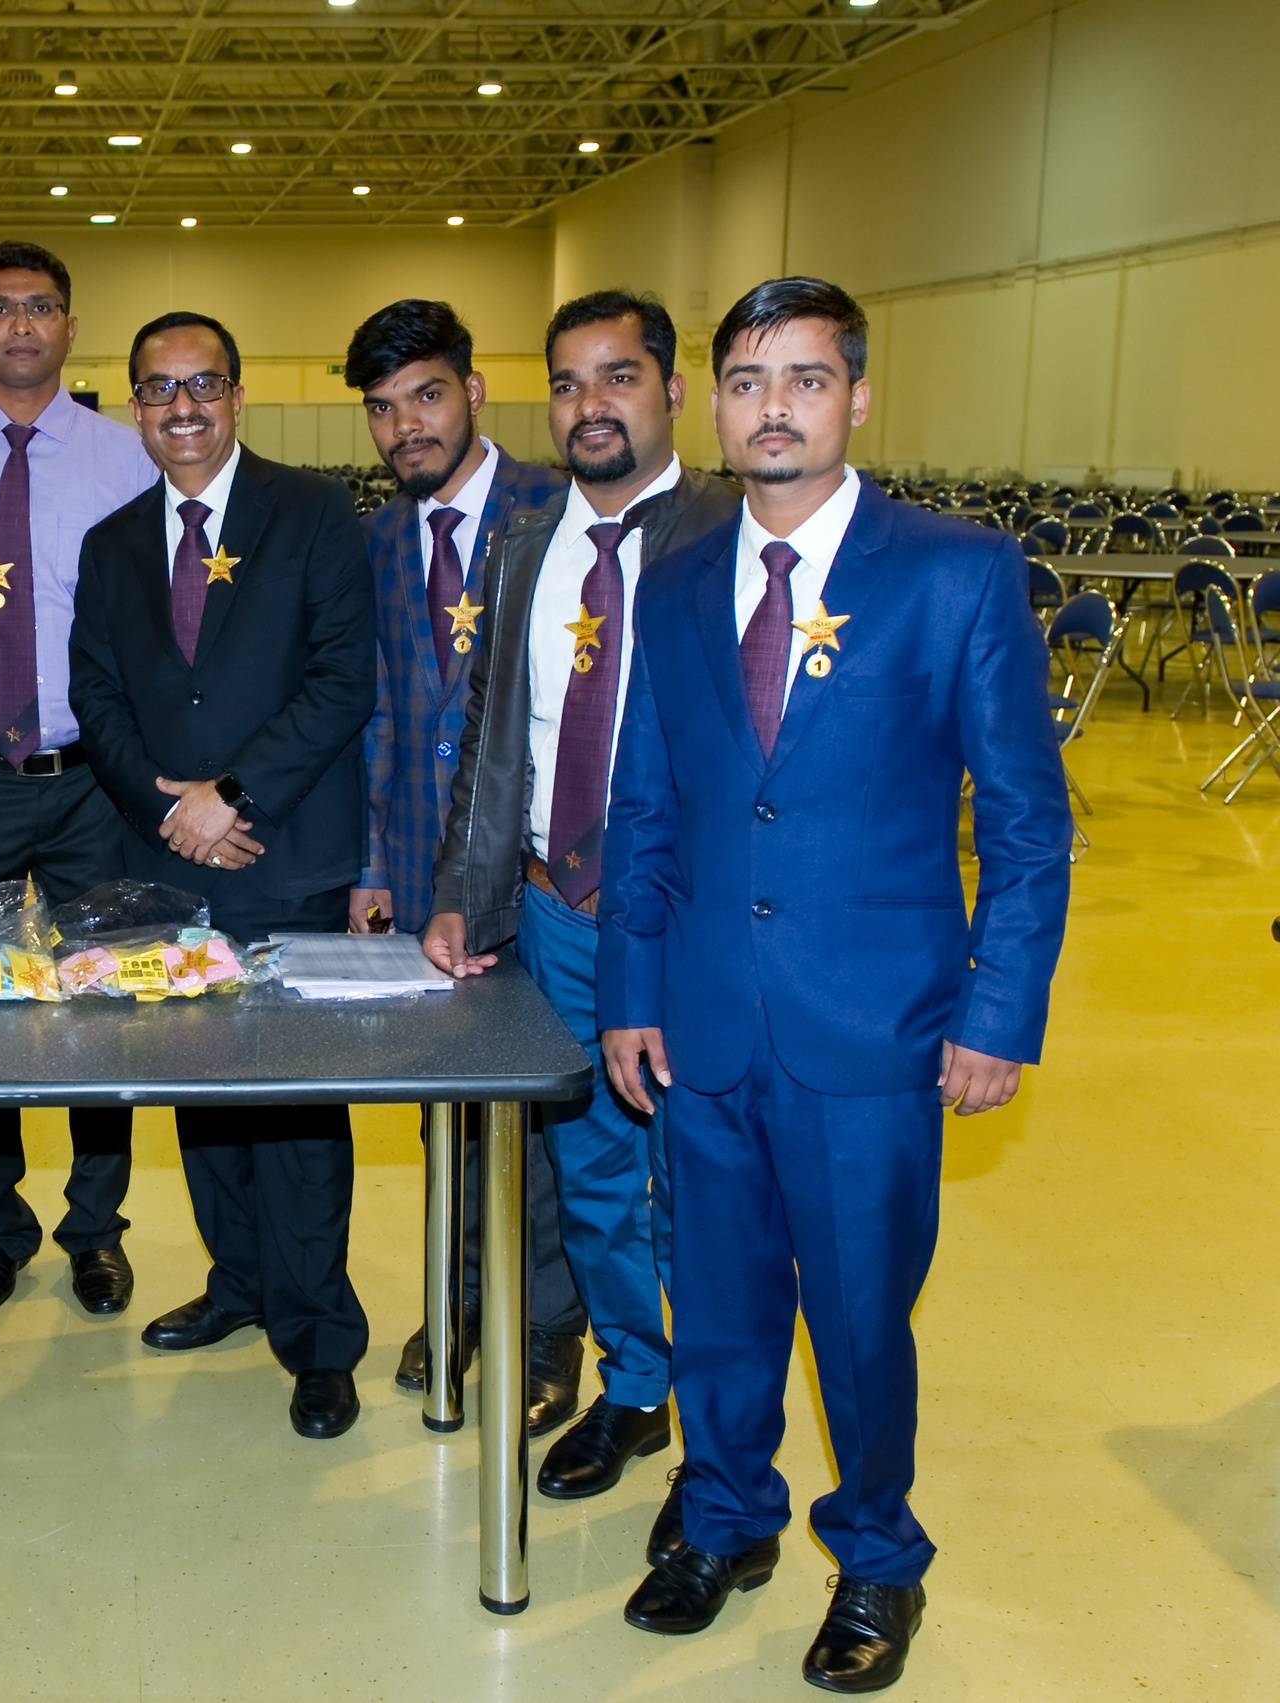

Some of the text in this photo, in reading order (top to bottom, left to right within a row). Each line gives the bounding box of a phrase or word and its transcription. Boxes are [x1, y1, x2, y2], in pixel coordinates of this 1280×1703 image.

[459, 640, 466, 650] 1
[579, 658, 585, 668] 1
[814, 660, 822, 672] 1
